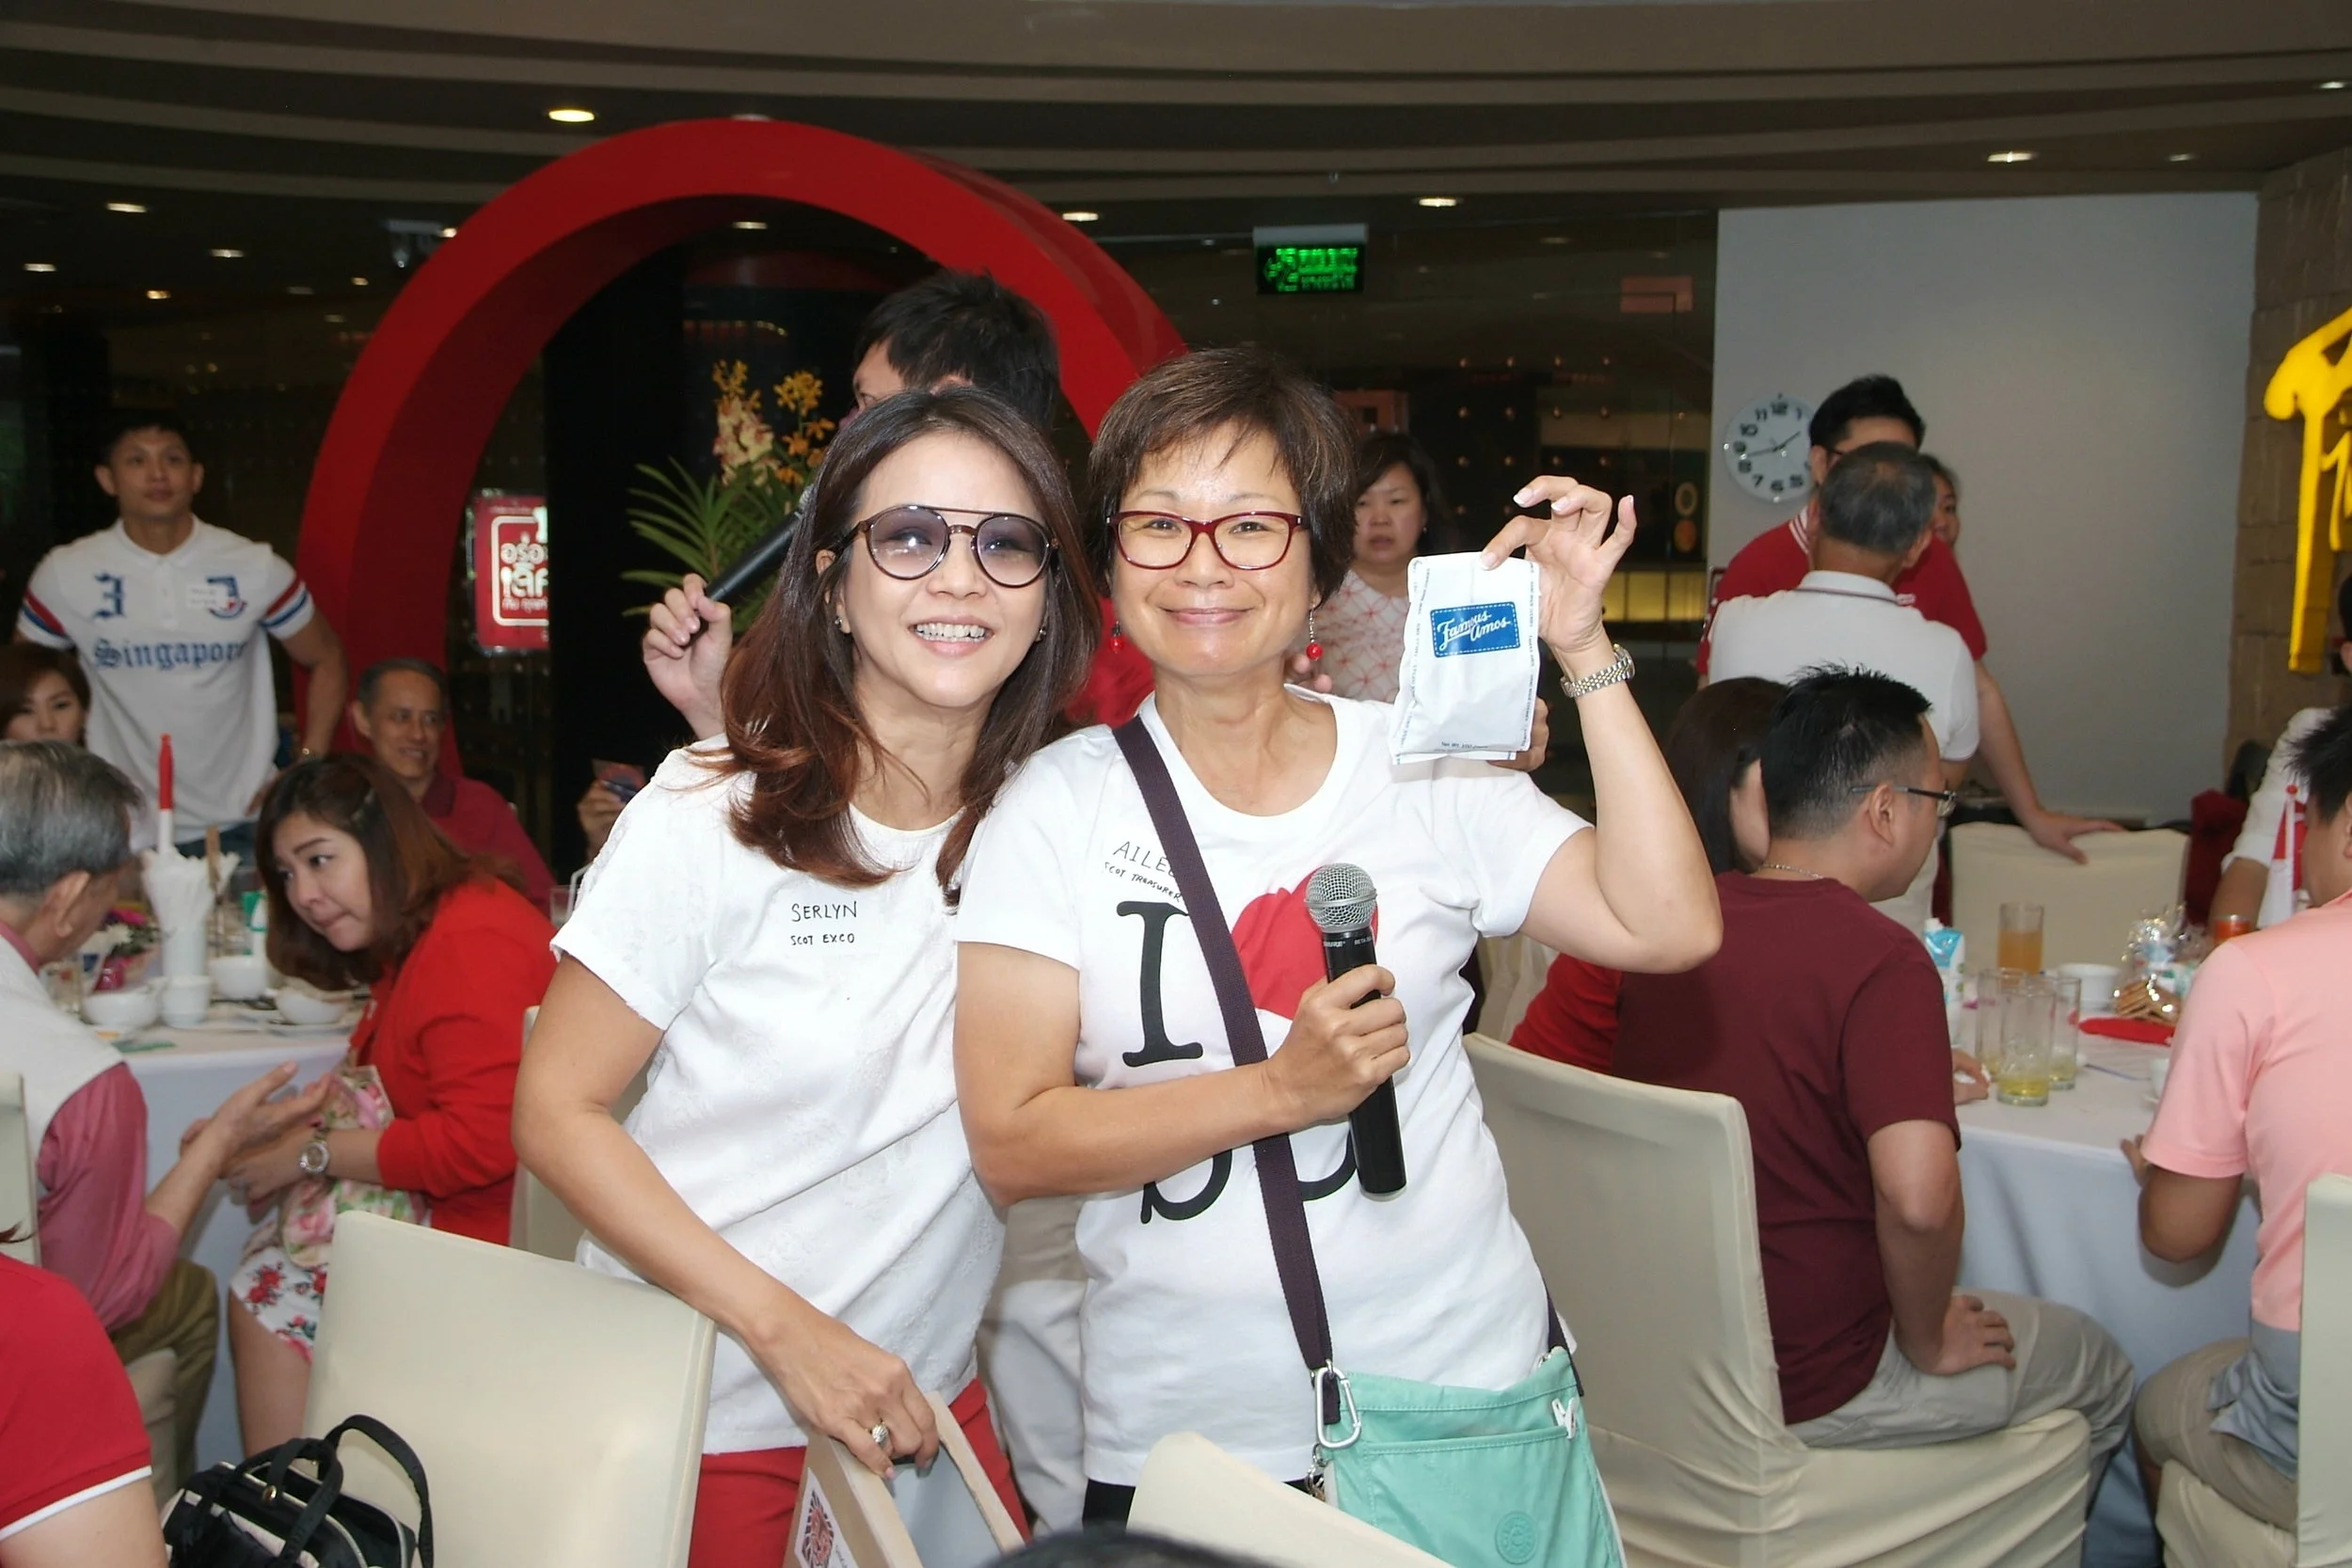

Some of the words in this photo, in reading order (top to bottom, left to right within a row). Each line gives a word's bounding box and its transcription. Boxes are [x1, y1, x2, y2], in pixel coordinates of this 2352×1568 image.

[501, 531, 548, 564] อร่อ
[1437, 610, 1492, 651] Famous
[1470, 616, 1511, 641] Amos
[1131, 873, 1182, 903] TREASURER
[791, 900, 857, 923] SERLYN
[790, 935, 814, 946] SCOT
[822, 933, 855, 943] EXCO
